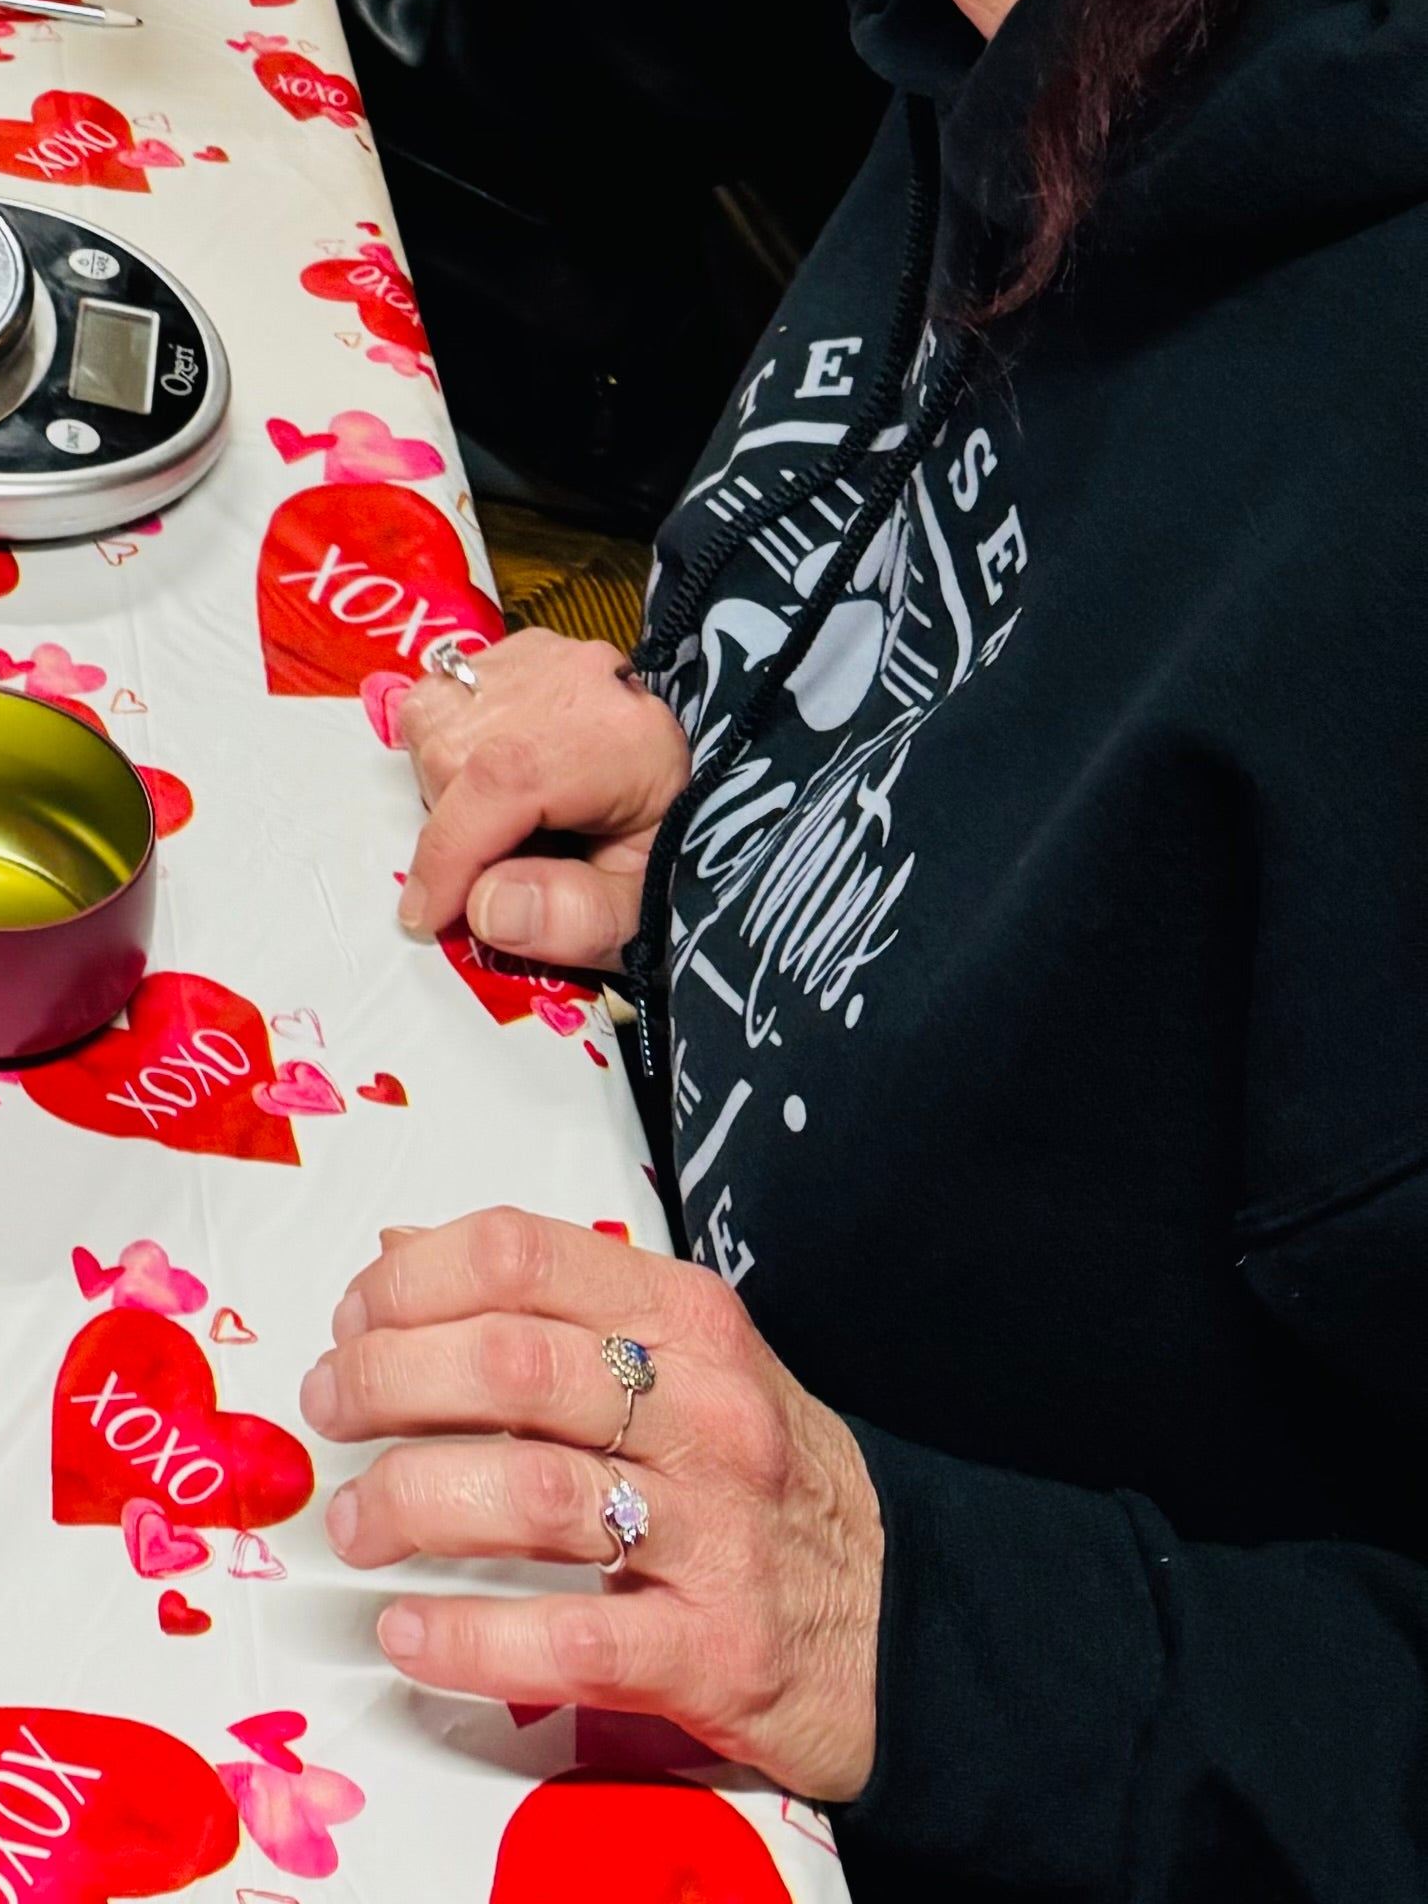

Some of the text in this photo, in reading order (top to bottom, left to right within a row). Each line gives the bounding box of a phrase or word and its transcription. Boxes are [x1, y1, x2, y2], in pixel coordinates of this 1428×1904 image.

[277, 74, 349, 106] XOXO
[15, 120, 119, 179] XOXO
[160, 343, 199, 396] Ozeri
[106, 1028, 251, 1130] XOXO
[70, 1371, 225, 1505] XOXO
